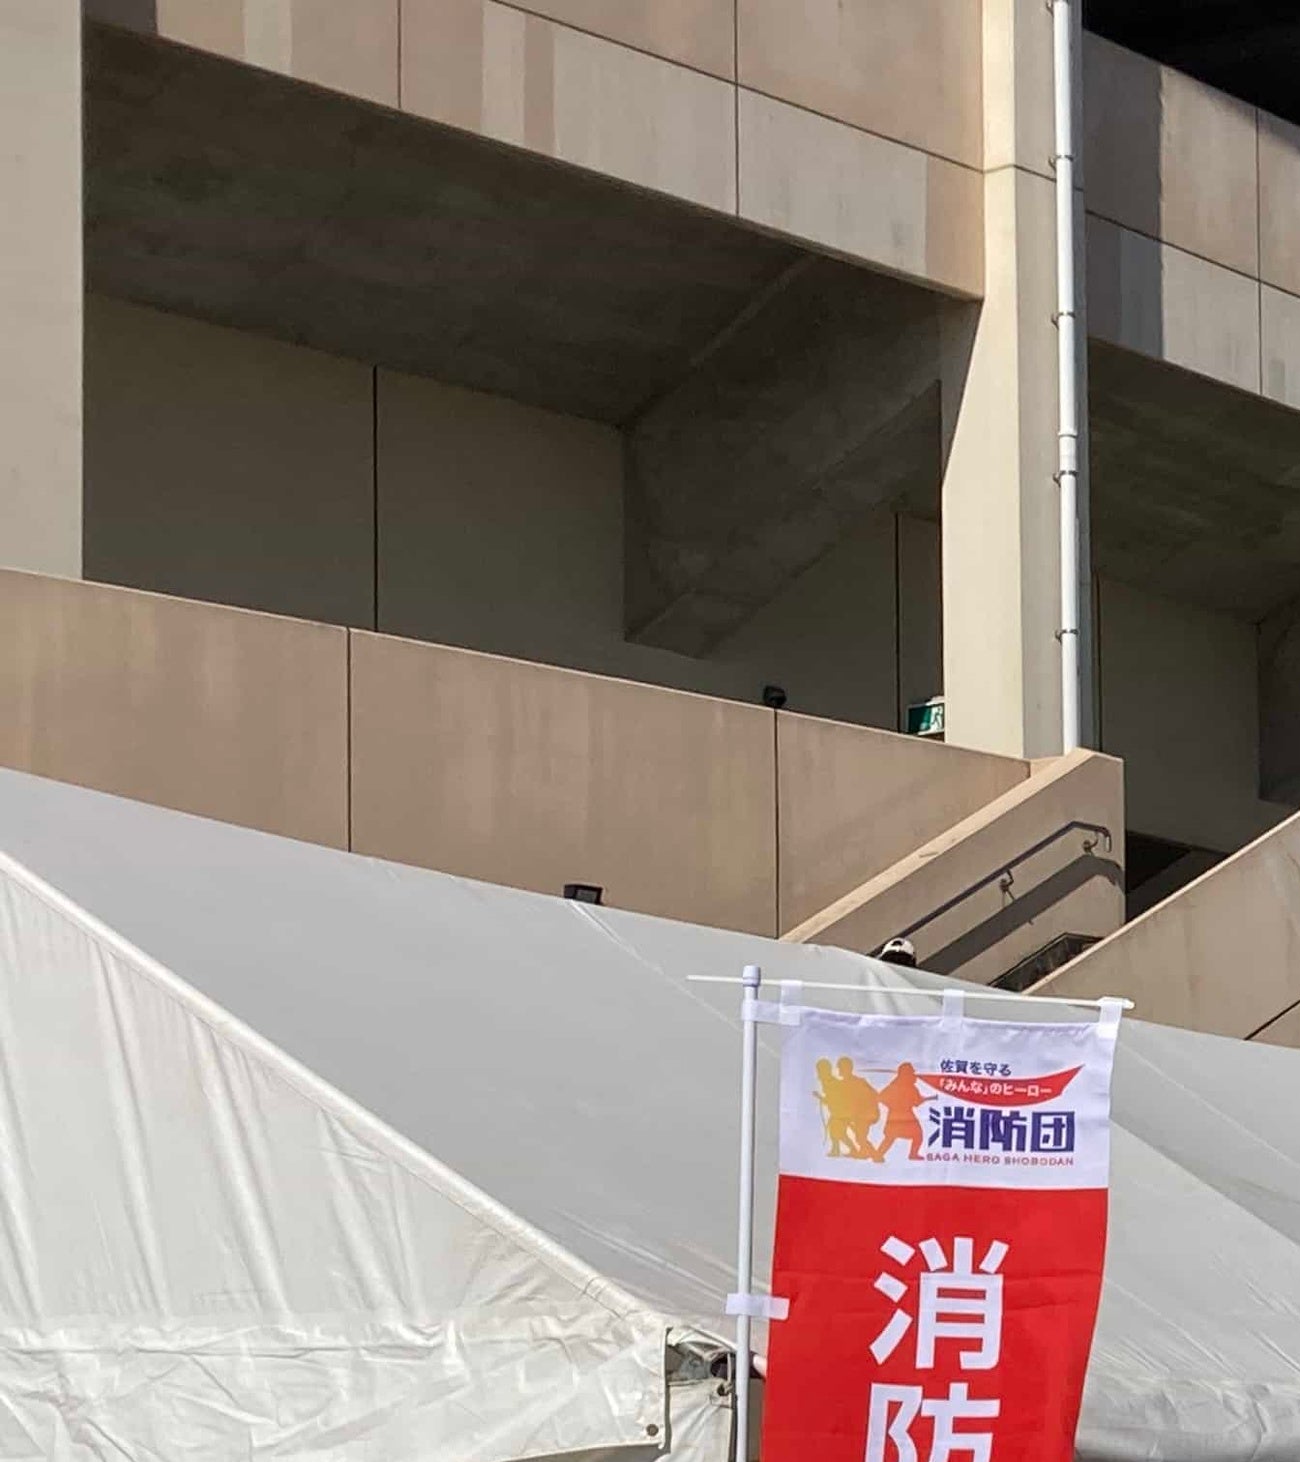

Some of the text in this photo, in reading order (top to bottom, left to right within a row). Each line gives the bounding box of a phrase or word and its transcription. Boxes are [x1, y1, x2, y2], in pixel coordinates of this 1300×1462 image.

[939, 1058, 1012, 1077] 佐賀を守る
[937, 1076, 1053, 1098] 「みんな」のヒーロー
[927, 1106, 1076, 1154] 消防団
[926, 1152, 1075, 1168] SAGA HERO SHOBODAN
